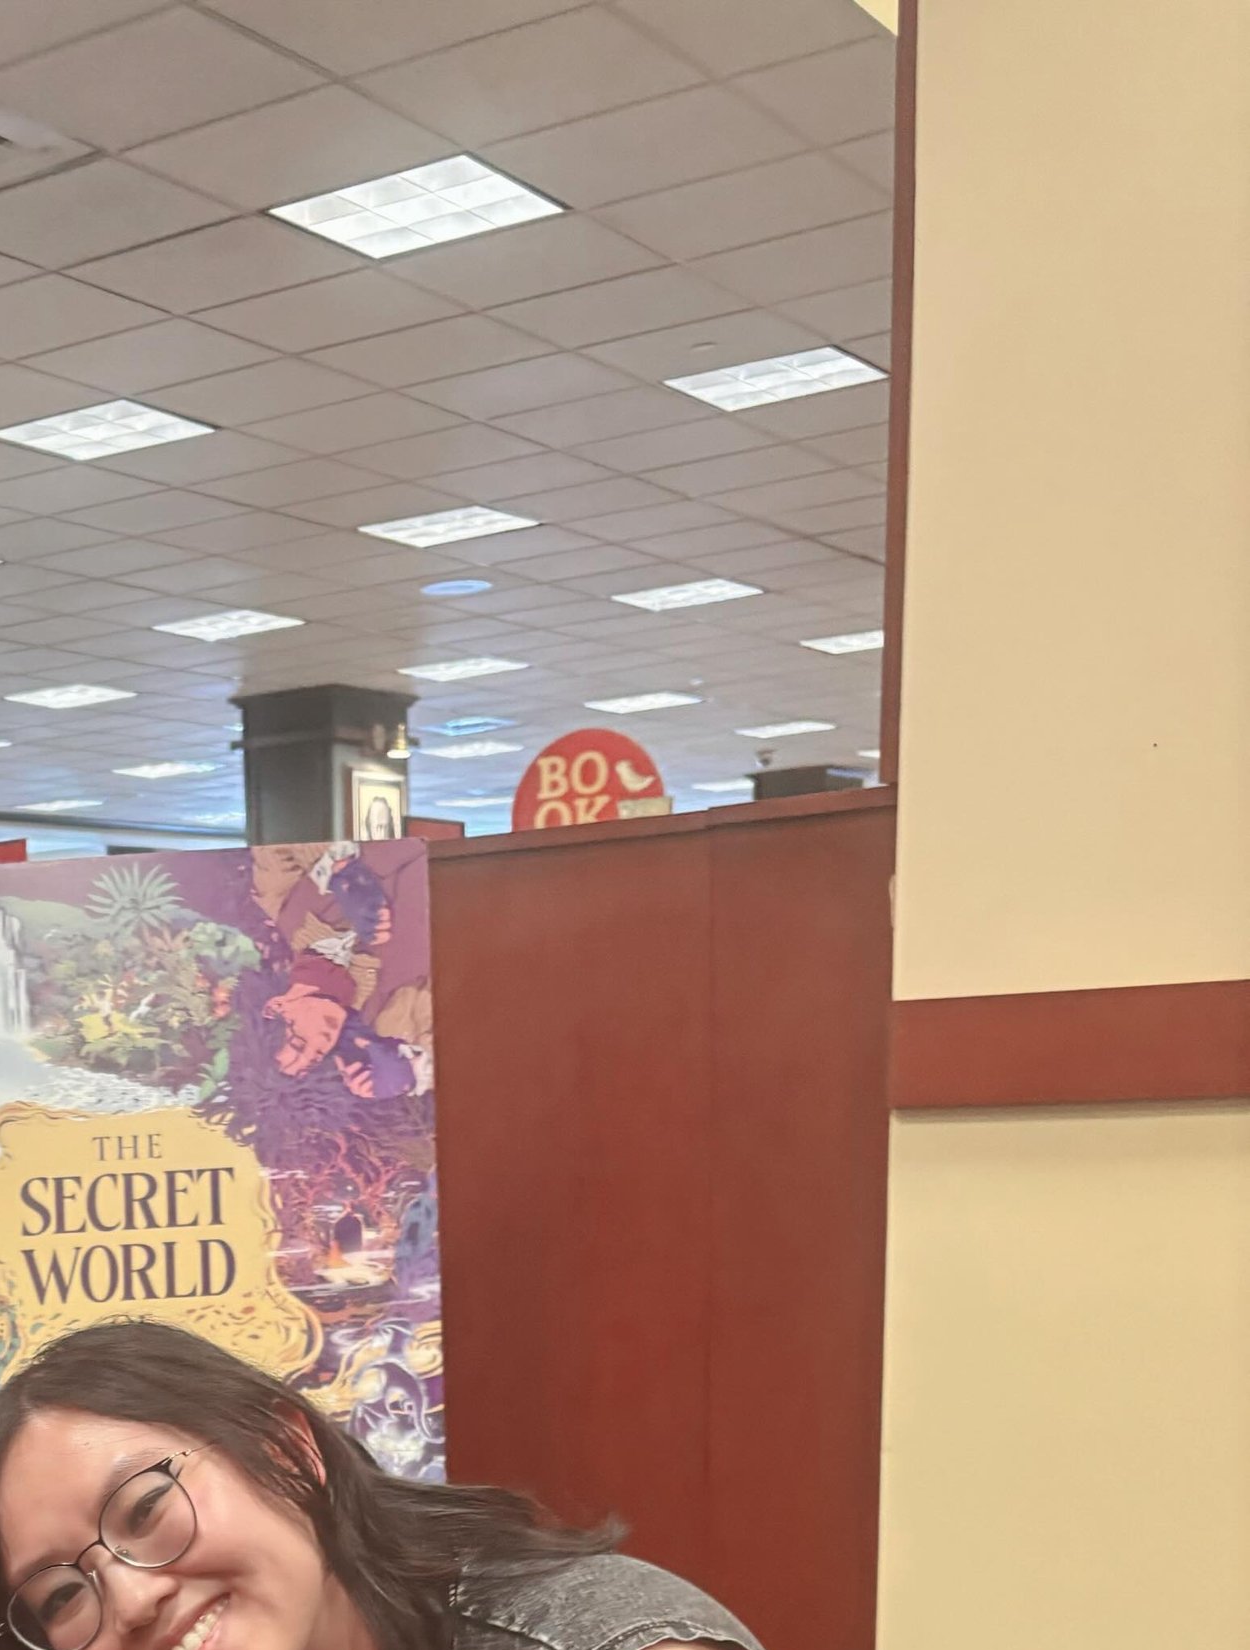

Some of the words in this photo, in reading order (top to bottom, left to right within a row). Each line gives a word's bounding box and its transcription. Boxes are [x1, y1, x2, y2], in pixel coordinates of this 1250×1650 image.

[537, 750, 608, 800] BO
[534, 795, 610, 830] OK
[92, 1133, 163, 1161] THE
[20, 1167, 235, 1237] SECRET
[20, 1239, 236, 1305] WORLD
